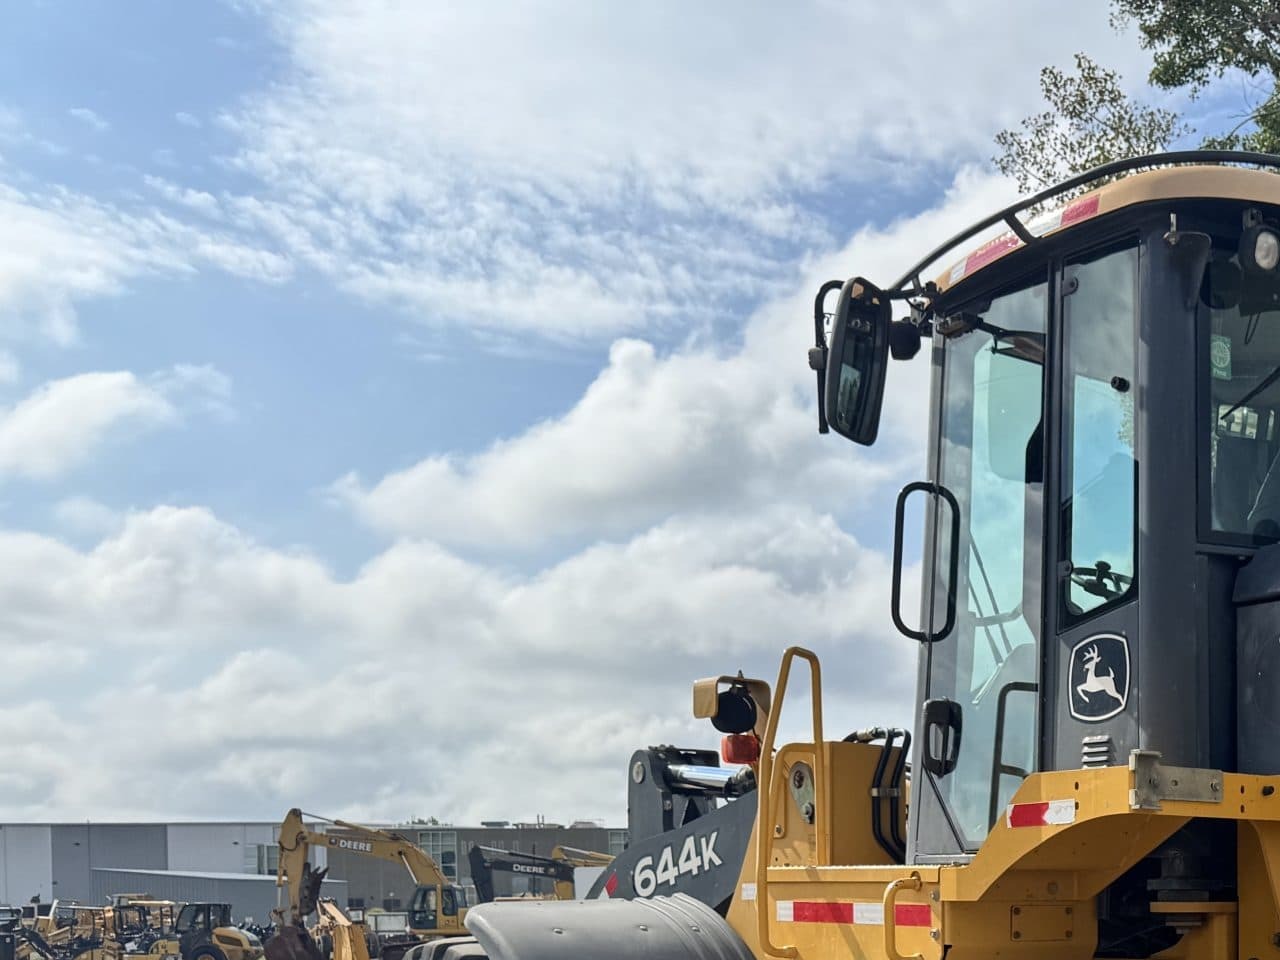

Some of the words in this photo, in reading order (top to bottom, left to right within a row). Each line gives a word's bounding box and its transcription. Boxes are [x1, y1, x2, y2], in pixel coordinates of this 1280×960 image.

[339, 839, 373, 853] DEERE
[512, 863, 545, 874] DEERE
[633, 831, 723, 897] 644K
